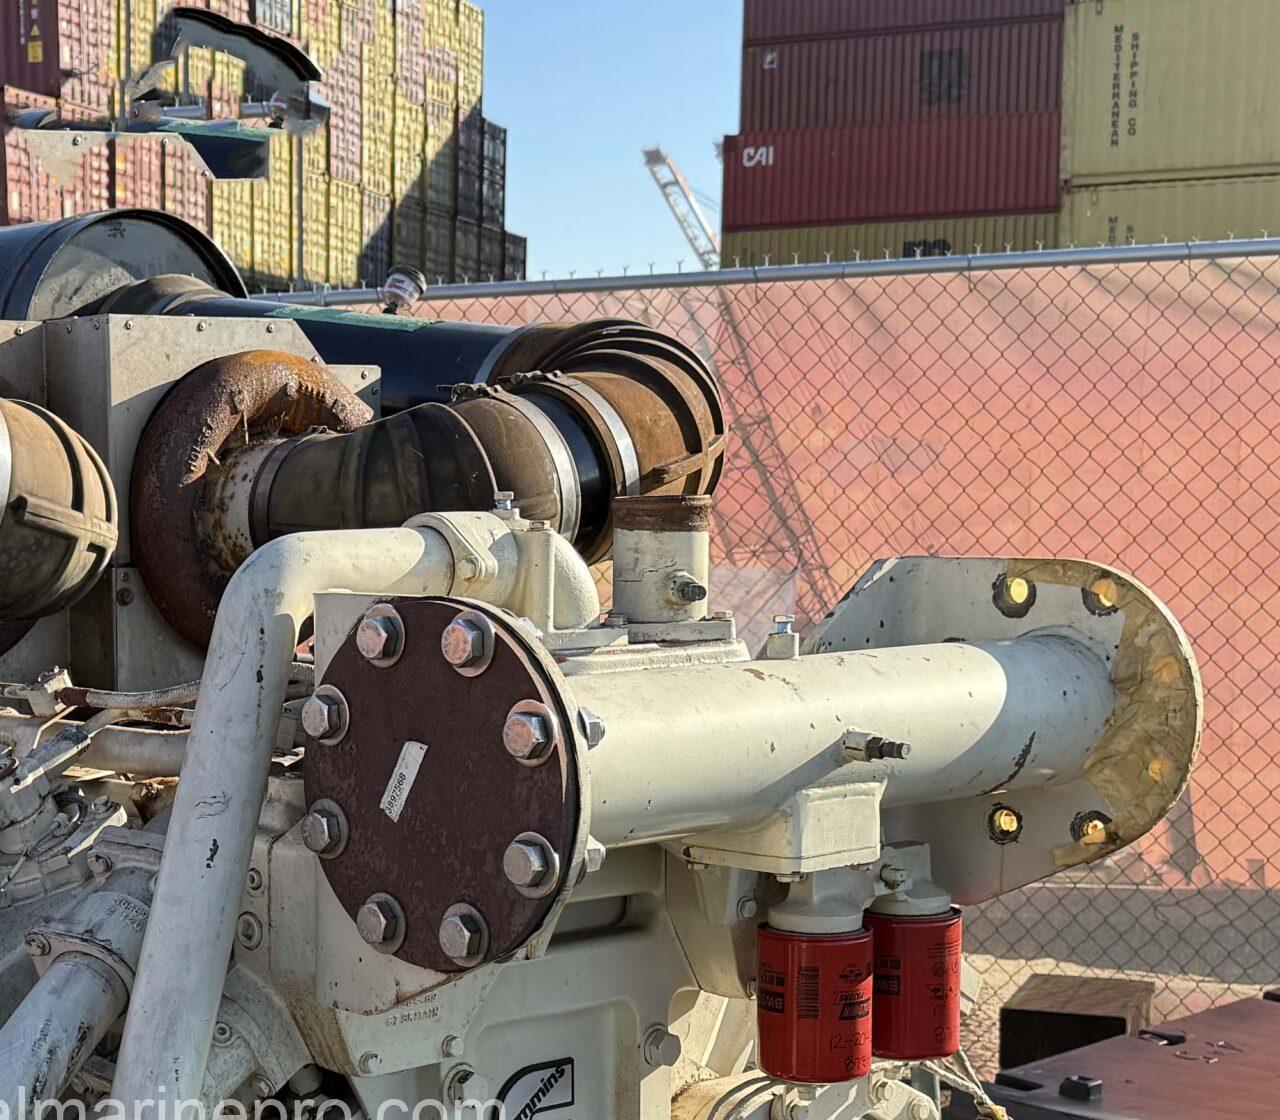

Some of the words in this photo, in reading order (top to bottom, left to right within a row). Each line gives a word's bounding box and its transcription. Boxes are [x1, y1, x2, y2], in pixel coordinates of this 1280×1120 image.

[1110, 24, 1124, 147] MEDITERRANEAN
[1129, 32, 1140, 108] SHIPPING
[1127, 117, 1137, 136] CO
[742, 146, 775, 167] CAI
